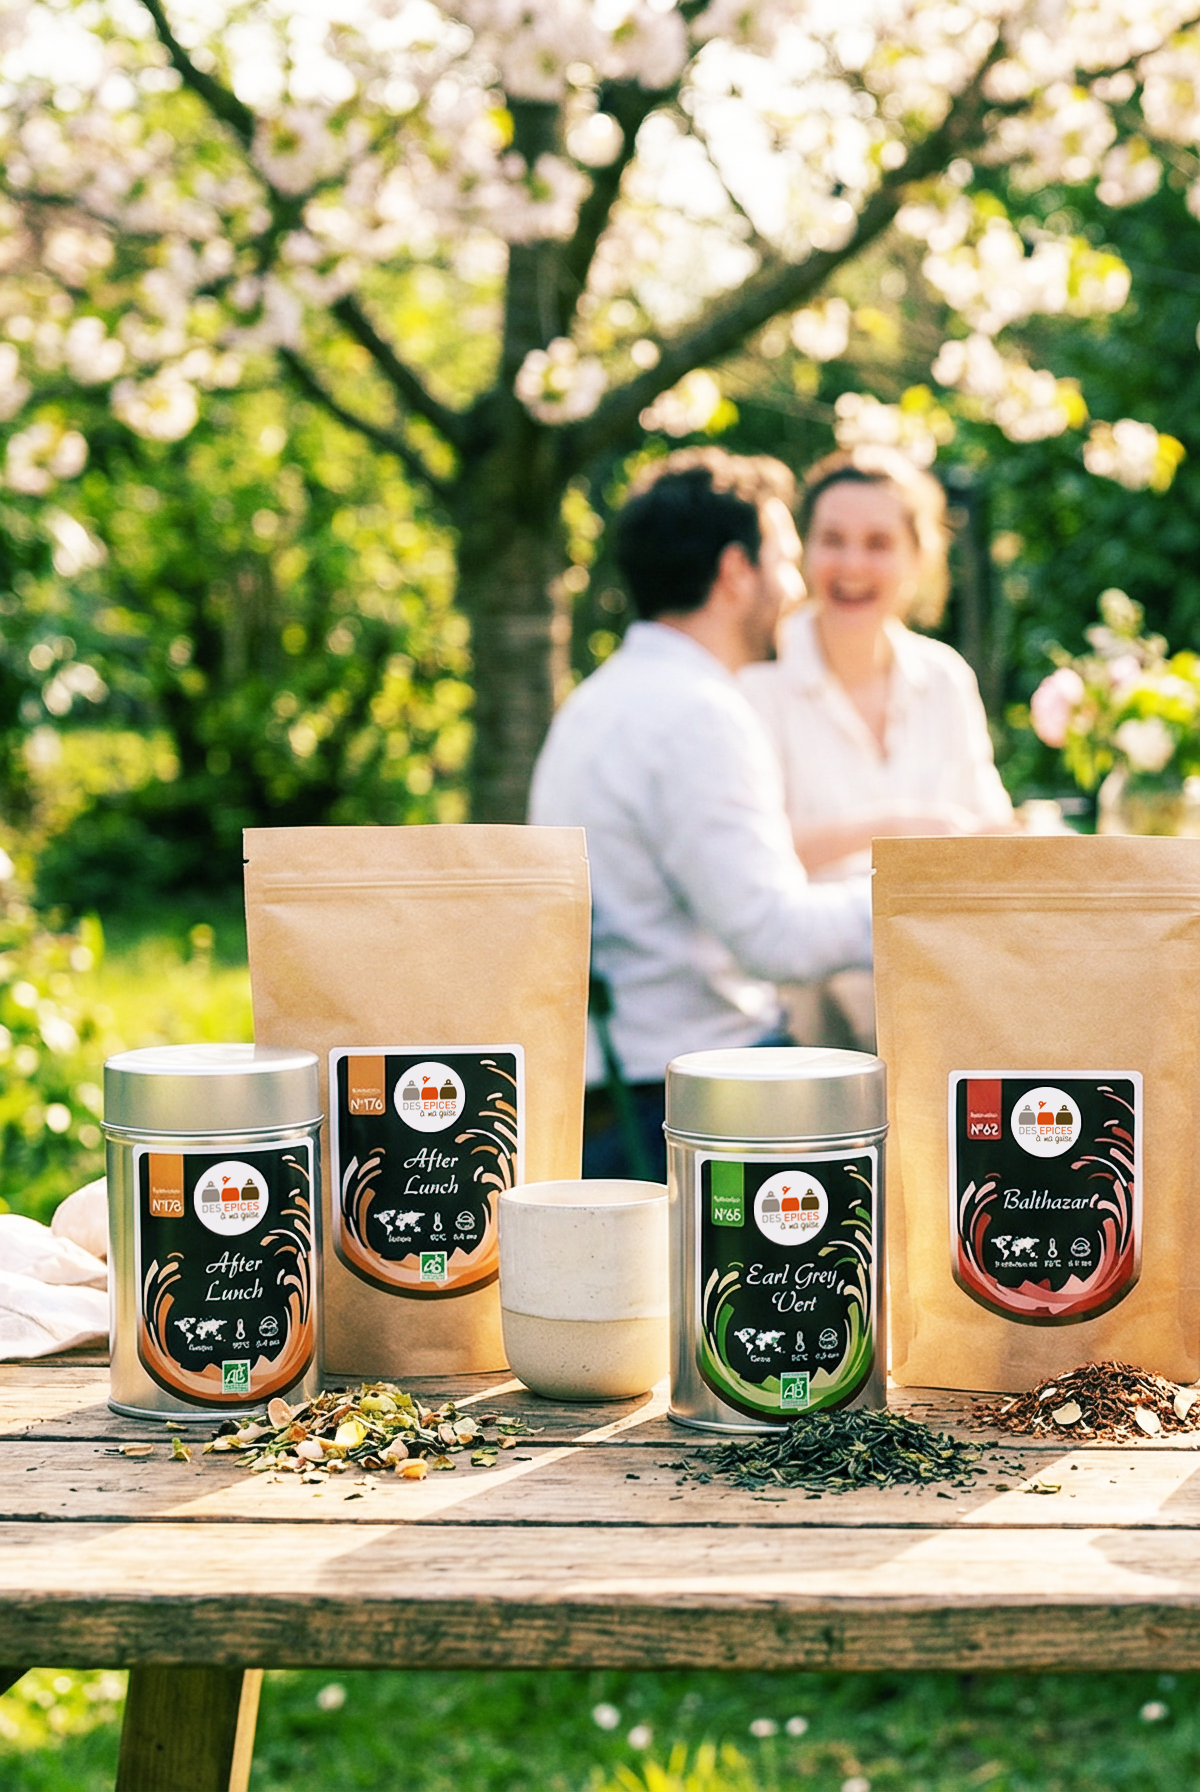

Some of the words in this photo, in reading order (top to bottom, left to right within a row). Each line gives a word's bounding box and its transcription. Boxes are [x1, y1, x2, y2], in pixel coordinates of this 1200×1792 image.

[403, 1102, 421, 1110] DES
[423, 1101, 457, 1110] EPICES
[1019, 1127, 1037, 1135] DES
[1039, 1127, 1073, 1135] EPICES
[403, 1147, 459, 1172] After
[403, 1174, 459, 1195] Lunch
[202, 1204, 221, 1213] DES
[224, 1202, 260, 1212] EPICES
[1003, 1189, 1089, 1210] Balthazar
[762, 1214, 782, 1223] DES
[784, 1212, 819, 1222] EPICES
[206, 1251, 262, 1278] After
[746, 1263, 790, 1285] Earl
[794, 1263, 837, 1289] Grey
[205, 1278, 263, 1301] Lunch
[772, 1291, 817, 1313] Vert
